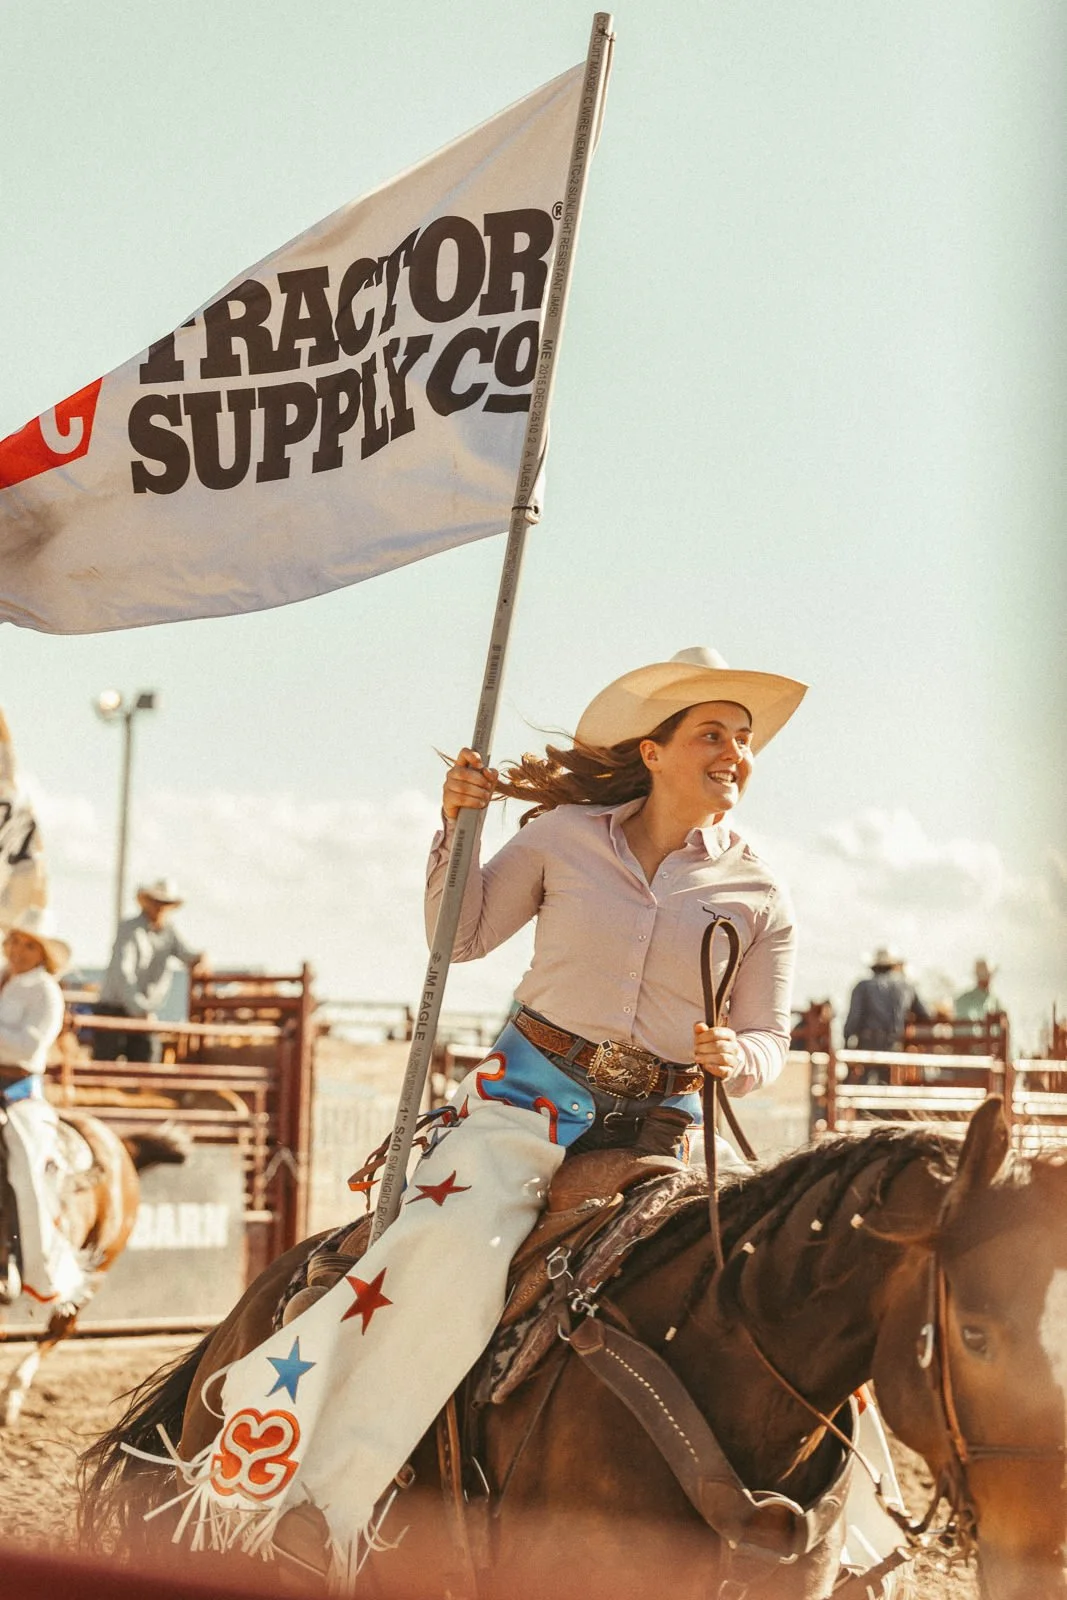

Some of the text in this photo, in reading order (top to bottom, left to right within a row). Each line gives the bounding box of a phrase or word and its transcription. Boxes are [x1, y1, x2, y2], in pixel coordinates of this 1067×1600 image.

[579, 106, 592, 131] WIRE
[574, 133, 587, 160] NEMA
[562, 187, 578, 234] SUNLIGHT
[552, 236, 570, 291] RESISTANT
[540, 338, 553, 361] ME
[533, 387, 545, 409] DEC
[128, 334, 433, 495] SUPPLY
[414, 966, 440, 1041] JM EAGLE
[391, 1125, 405, 1151] S40
[379, 1173, 394, 1204] RIGID
[374, 1206, 387, 1229] PVC
